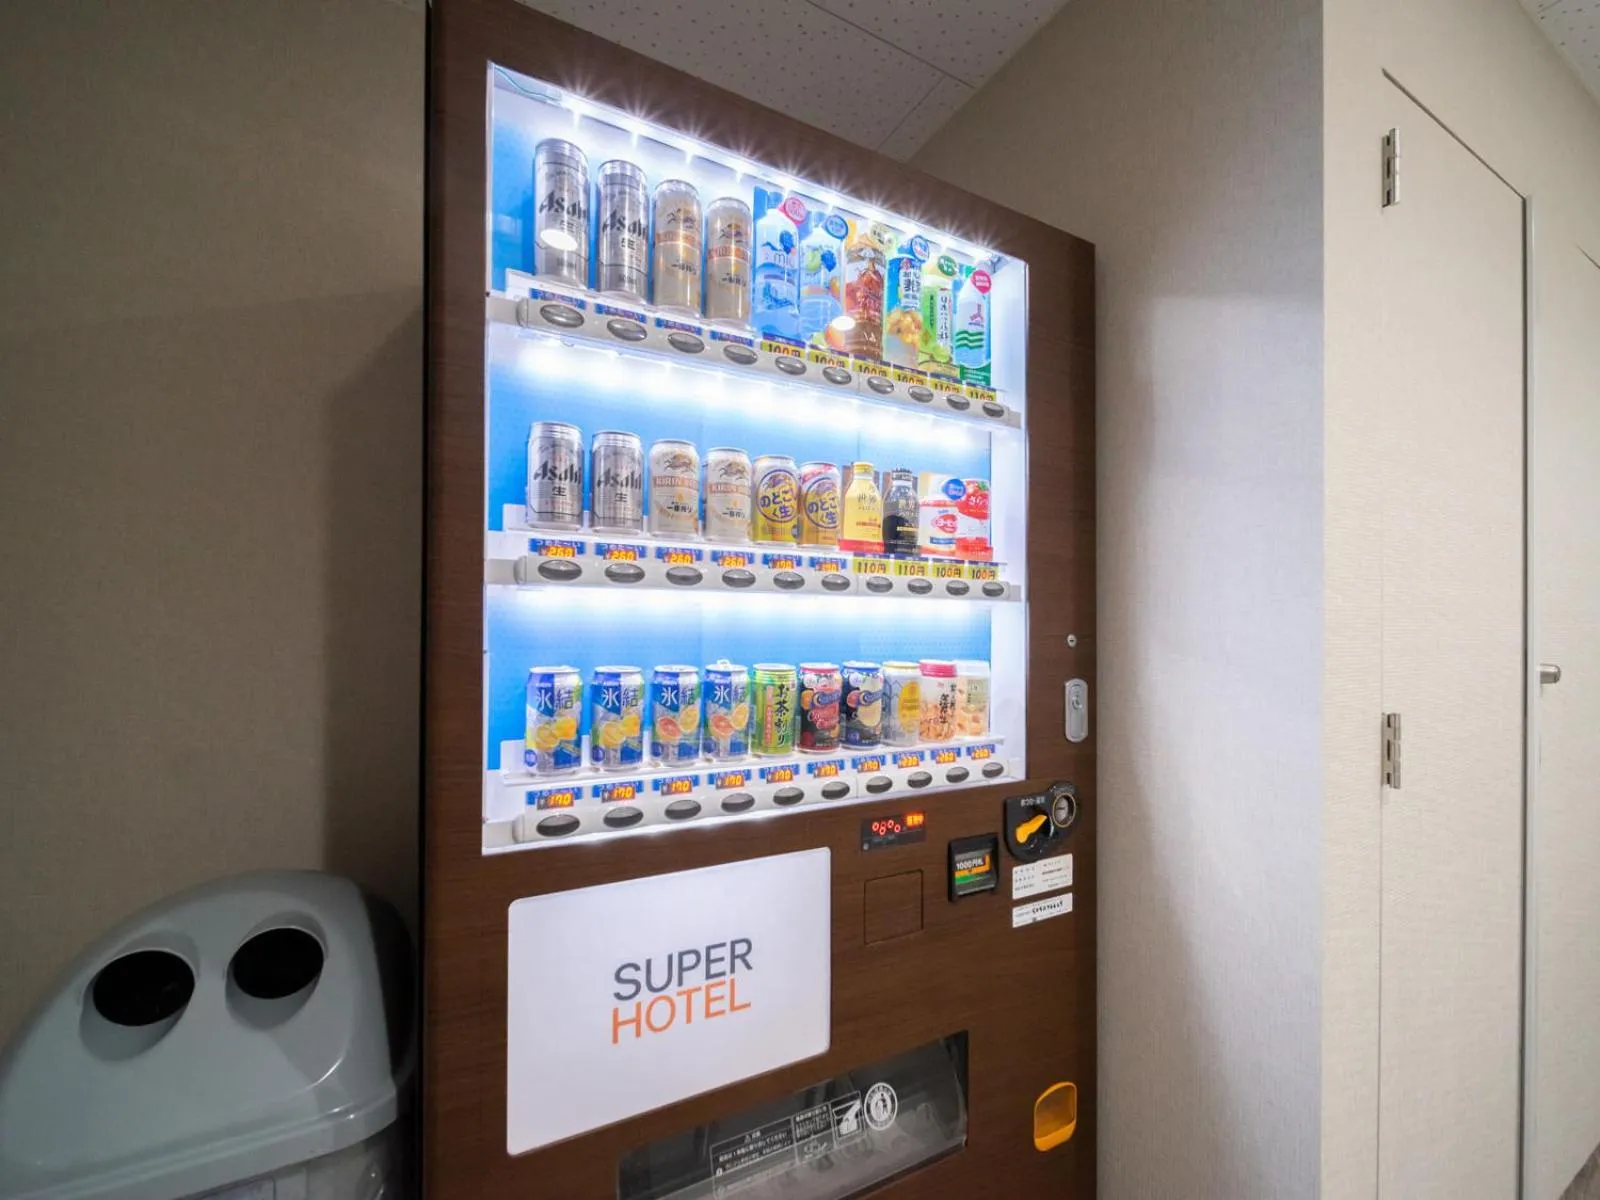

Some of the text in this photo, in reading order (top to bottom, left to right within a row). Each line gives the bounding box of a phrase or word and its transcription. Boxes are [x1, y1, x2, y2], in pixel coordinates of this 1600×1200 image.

[539, 191, 587, 219] Asah
[602, 210, 647, 237] Asah
[534, 460, 582, 484] Asahi
[597, 467, 642, 489] Asahi
[552, 486, 567, 497] 生
[537, 689, 574, 711] 氷結
[600, 688, 639, 708] 氷結
[613, 938, 752, 1001] SUPER
[612, 978, 751, 1044] HOTEL
